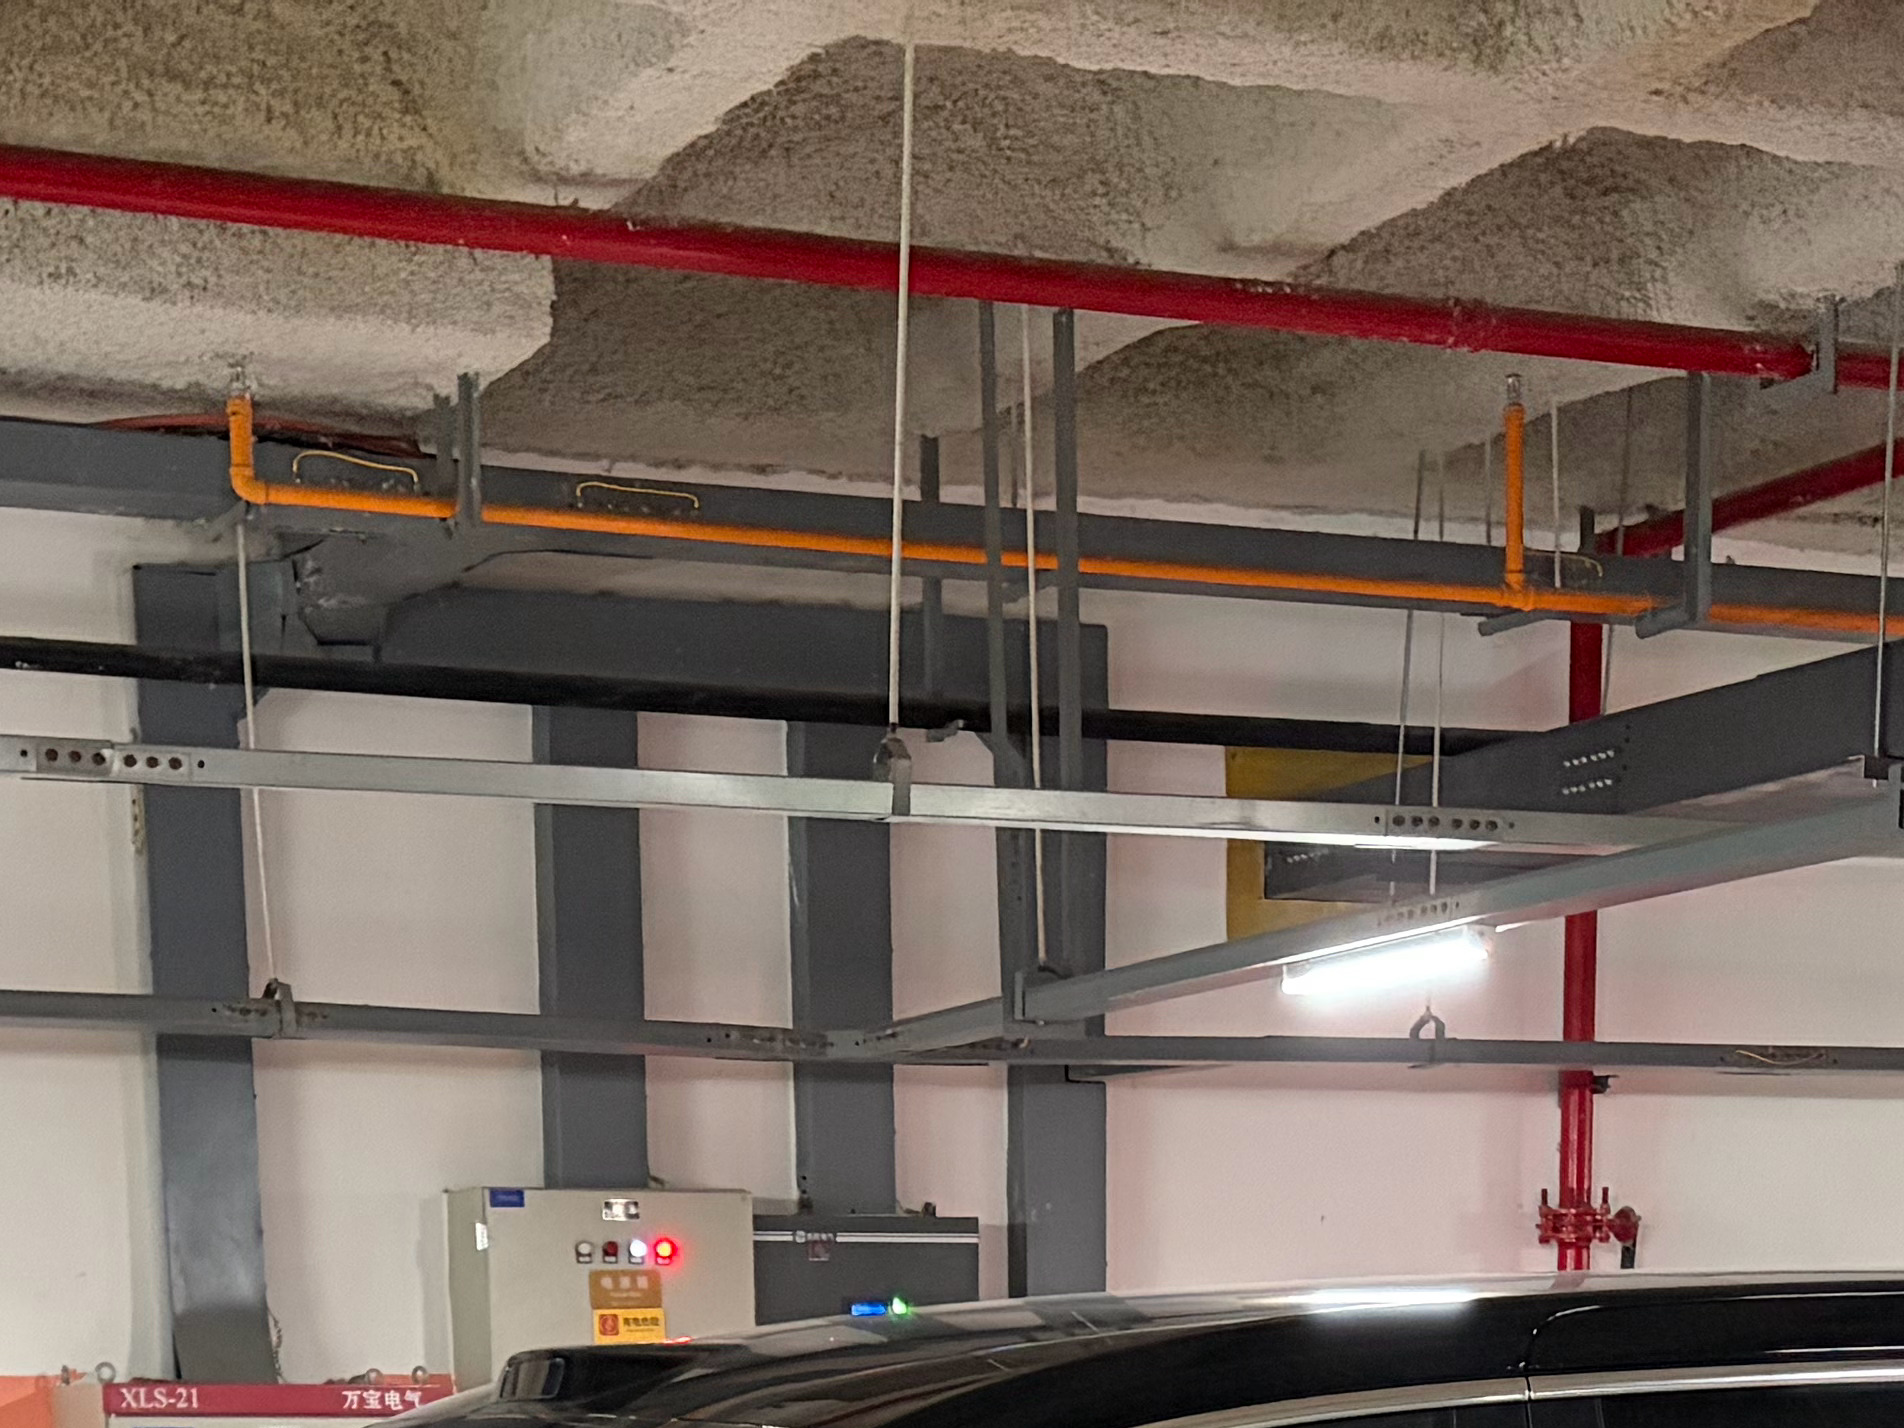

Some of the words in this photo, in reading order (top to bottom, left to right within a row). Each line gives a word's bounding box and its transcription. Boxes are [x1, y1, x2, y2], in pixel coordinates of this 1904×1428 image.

[120, 1387, 199, 1409] XLS-21
[341, 1389, 423, 1411] 万宝电气
